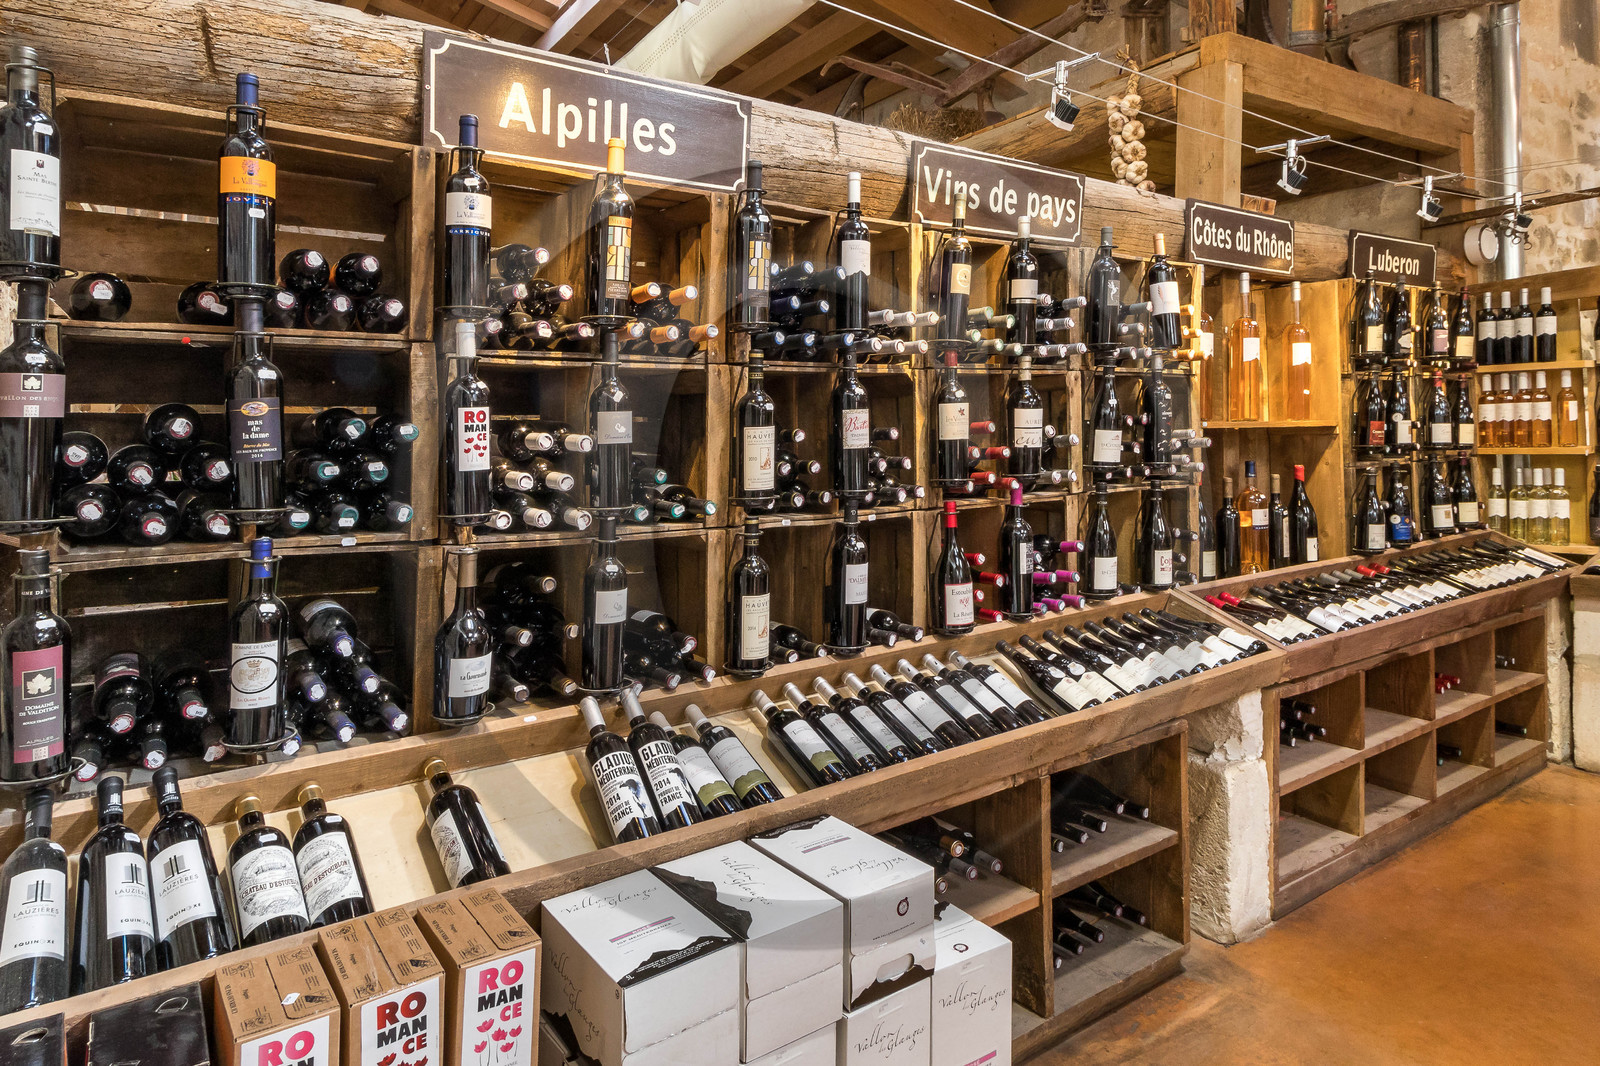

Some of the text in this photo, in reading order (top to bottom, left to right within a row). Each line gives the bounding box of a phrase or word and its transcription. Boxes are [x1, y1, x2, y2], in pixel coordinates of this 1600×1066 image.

[498, 82, 677, 156] Alpilles
[226, 196, 272, 206] LOVELY
[923, 165, 1078, 229] Vins de pays
[1193, 216, 1293, 262] Côtes du Rhône
[1368, 246, 1420, 278] Luberon
[464, 410, 486, 424] RO
[242, 432, 249, 440] la
[464, 424, 487, 432] MAN
[477, 432, 487, 441] CE
[24, 701, 54, 711] DOMAINE
[27, 704, 60, 716] VALDITION
[641, 742, 676, 761] GLADIU
[594, 752, 636, 778] GLADIUS
[654, 777, 672, 791] 2014
[658, 787, 674, 798] PRODUIT
[606, 792, 621, 810] 2014
[660, 792, 684, 806] FRANCE
[611, 805, 634, 826] FRANCE
[13, 906, 60, 919] LAUZIÈRES
[478, 960, 524, 996] RO
[477, 984, 523, 1013] MAN
[938, 980, 978, 1009] Vallon
[968, 985, 1008, 1016] Glauges
[376, 990, 427, 1031] RO
[500, 1001, 523, 1022] CE
[376, 1014, 428, 1048] MAN
[854, 1020, 895, 1054] Vallon
[886, 1024, 926, 1058] Glauges
[258, 1030, 314, 1066] RO
[402, 1032, 428, 1054] CE
